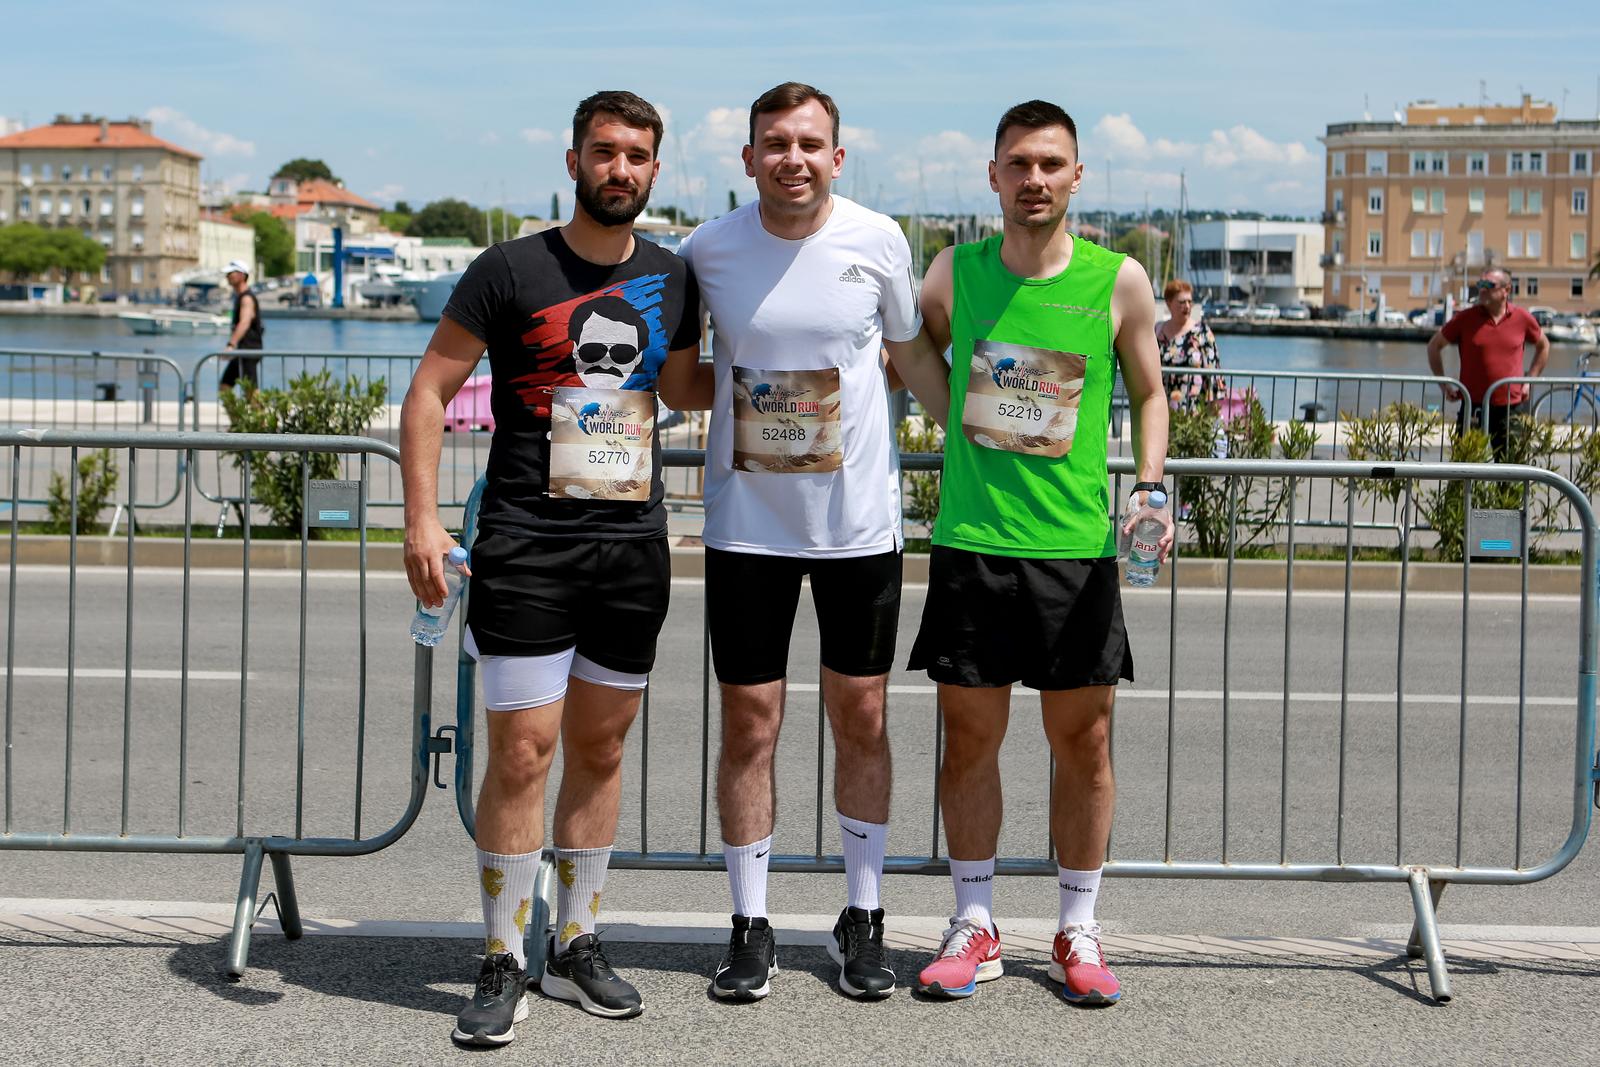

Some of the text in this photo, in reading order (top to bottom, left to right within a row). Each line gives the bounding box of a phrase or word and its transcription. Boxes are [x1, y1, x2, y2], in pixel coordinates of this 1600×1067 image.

[839, 276, 866, 284] adidas
[1003, 376, 1060, 395] WORLD RUN
[762, 401, 819, 413] WORLD RUN
[998, 403, 1042, 421] 52219
[590, 422, 641, 435] WORLD RUN
[762, 428, 806, 440] 52488
[588, 451, 630, 464] 52770
[1134, 540, 1157, 552] Jana
